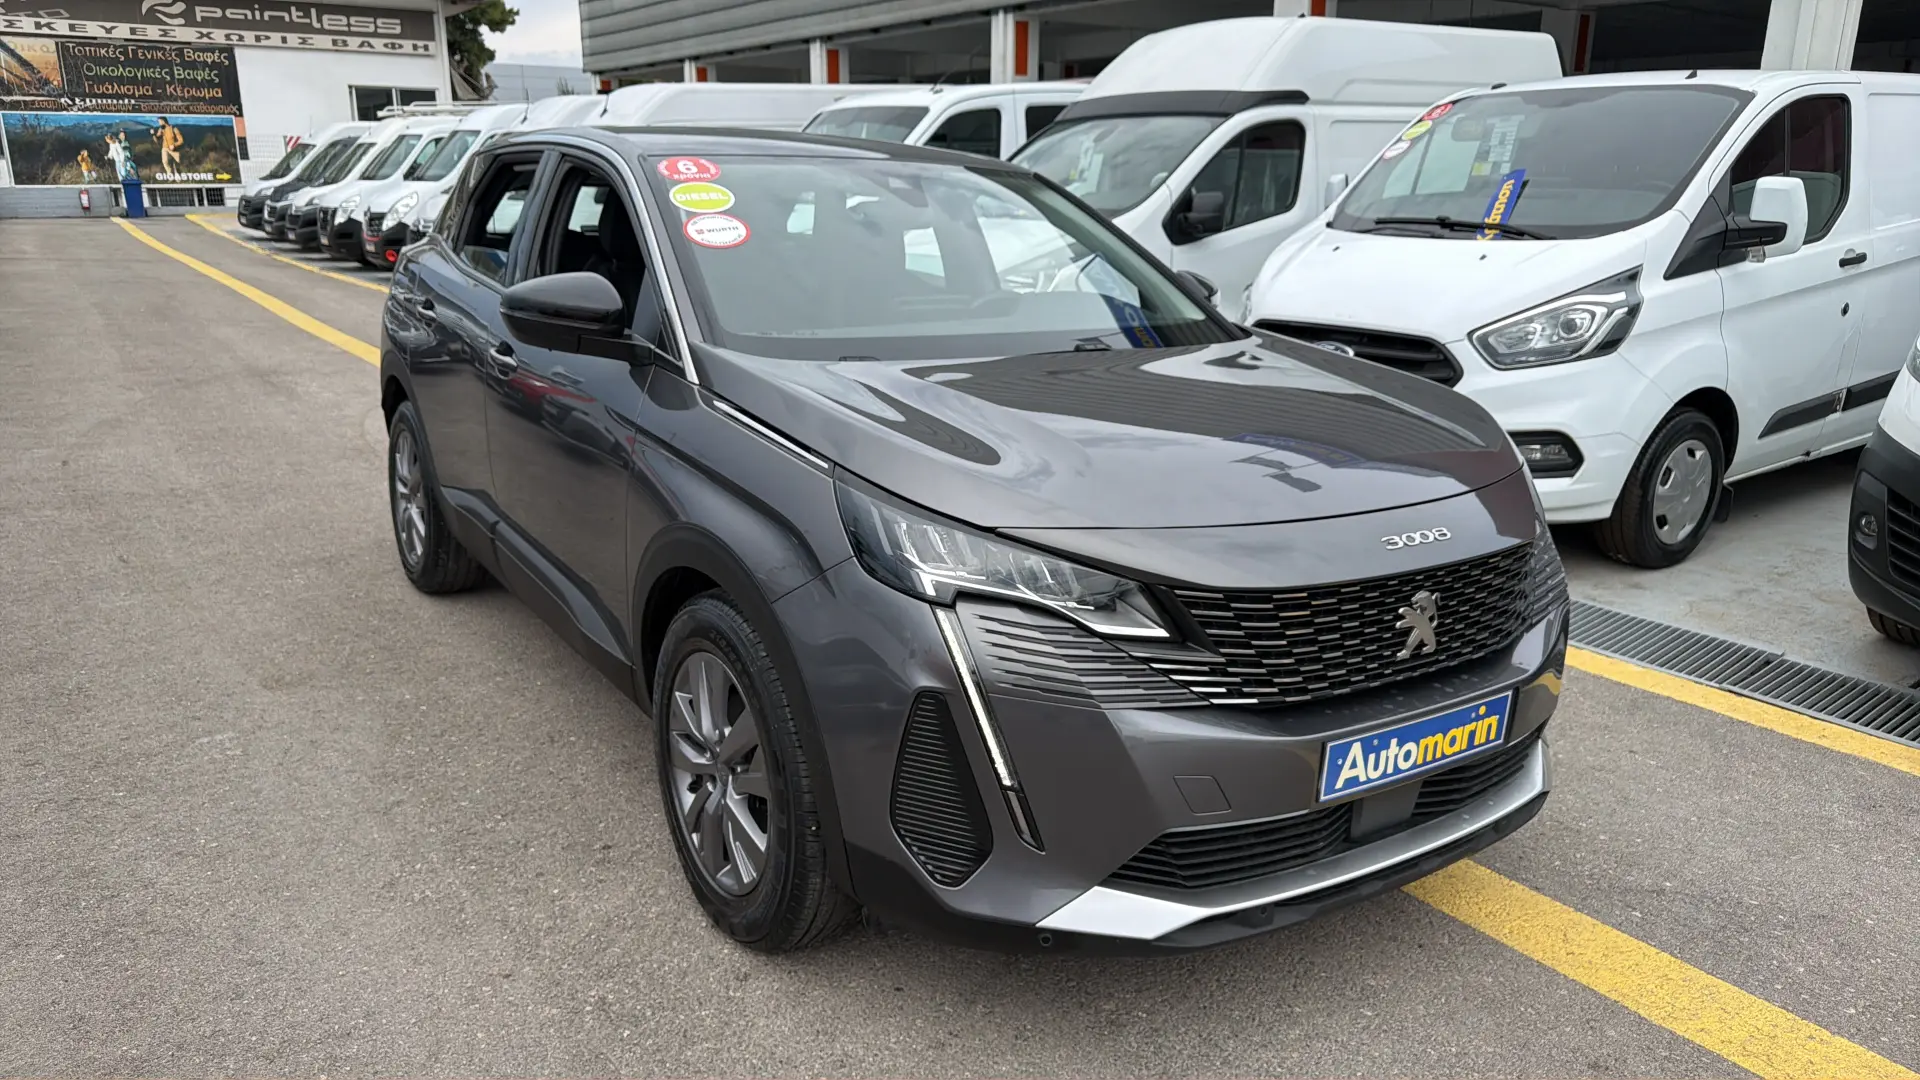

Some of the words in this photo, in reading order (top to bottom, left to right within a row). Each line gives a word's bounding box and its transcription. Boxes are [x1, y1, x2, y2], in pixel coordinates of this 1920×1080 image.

[194, 4, 402, 35] paintless
[194, 30, 315, 46] ΧΩΡΙΣ
[331, 38, 430, 52] ΒΑΦΗ
[65, 43, 125, 61] Τοπικές
[128, 45, 180, 63] Γενικές
[184, 48, 229, 66] Βαφές
[83, 63, 171, 80] Οικολογικές
[174, 66, 220, 83] Βαφές
[85, 81, 153, 97] Γυάλισμα
[166, 84, 223, 99] Κέρωμα
[155, 172, 214, 181] GIGASTORE
[676, 160, 698, 174] 6
[675, 191, 729, 202] DIESEL
[1381, 527, 1452, 550] 3008
[1334, 705, 1500, 790] Automarin
